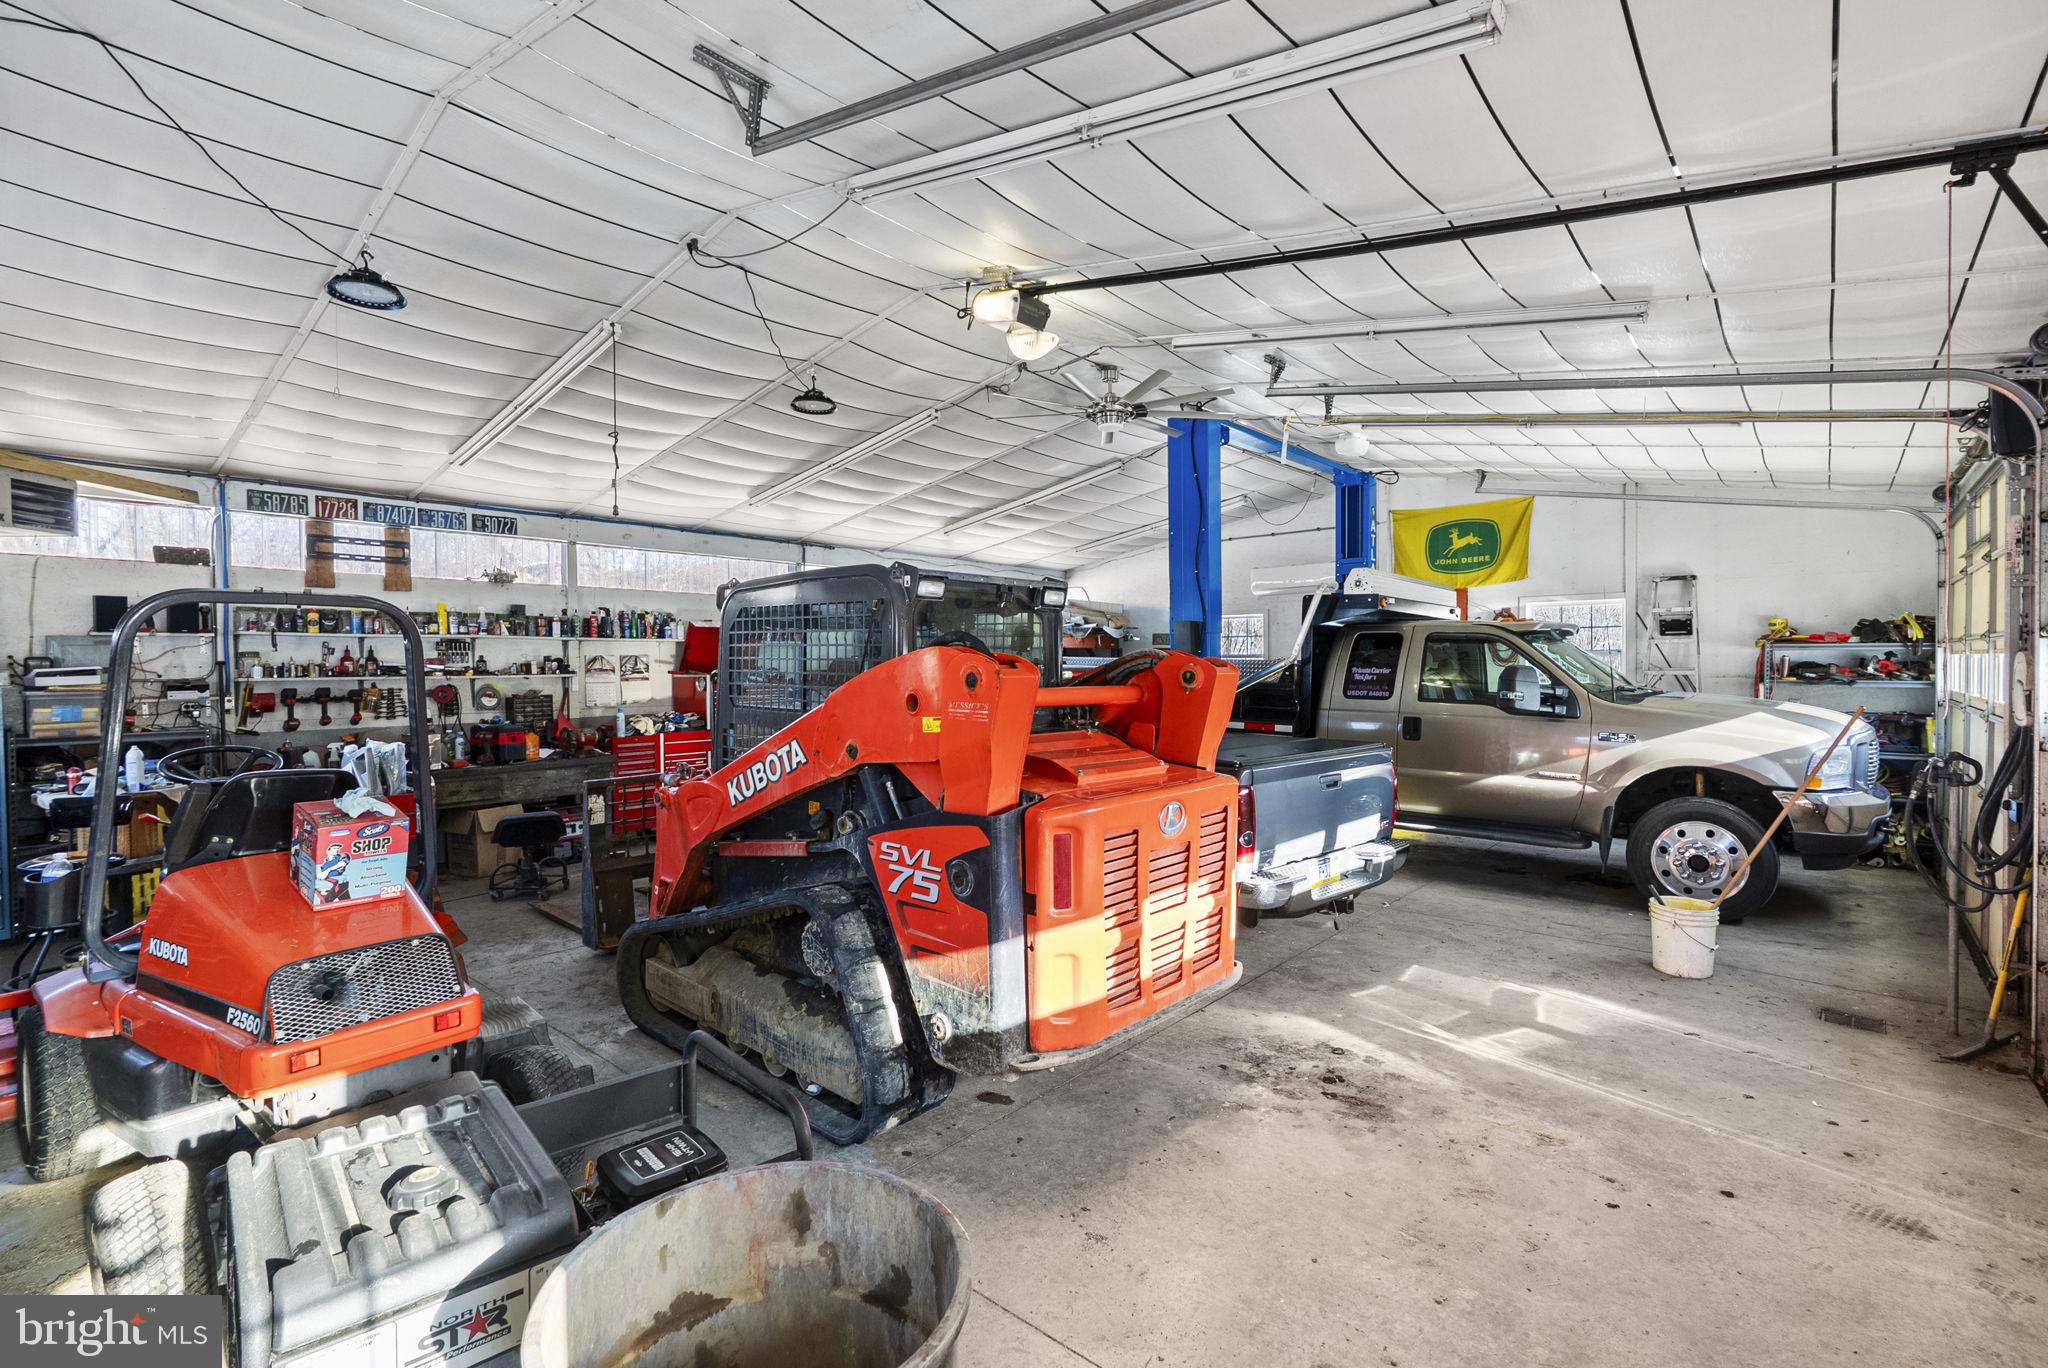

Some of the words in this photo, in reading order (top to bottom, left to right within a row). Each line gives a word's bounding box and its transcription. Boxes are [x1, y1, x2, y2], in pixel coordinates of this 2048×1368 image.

[263, 493, 307, 515] 58785
[377, 504, 415, 524] 87407
[431, 511, 466, 530] 36765
[484, 516, 517, 535] 90727
[1434, 558, 1458, 566] JOHN
[1461, 554, 1491, 564] DEERE
[725, 738, 808, 808] KUBOTA
[362, 825, 385, 837] Scott
[352, 836, 391, 854] SHOP
[879, 841, 942, 872] SVL
[380, 884, 402, 895] 200
[887, 863, 942, 904] 75
[149, 937, 188, 967] KUBOTA
[226, 1007, 261, 1036] F2560
[429, 1295, 506, 1333] NORTH
[445, 1327, 511, 1360] Performance
